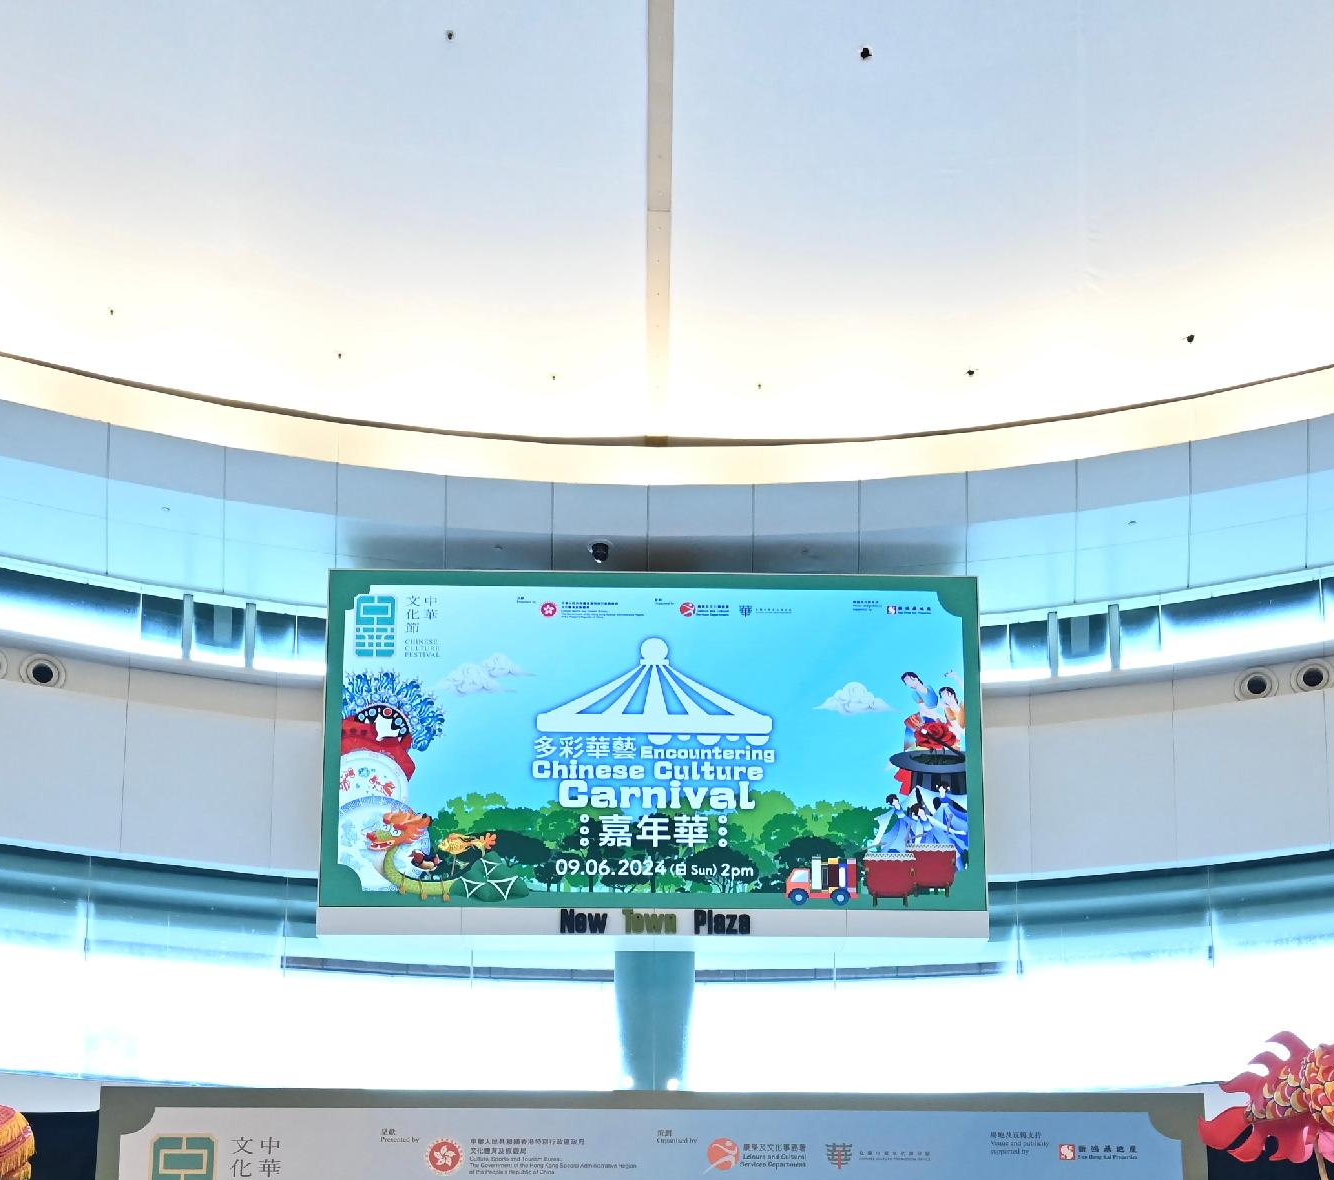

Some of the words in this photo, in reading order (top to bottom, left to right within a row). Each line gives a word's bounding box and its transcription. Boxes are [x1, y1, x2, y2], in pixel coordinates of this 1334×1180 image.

[534, 736, 637, 760] 多彩華藝
[640, 746, 775, 764] Encountering
[532, 760, 645, 780] Chinese
[654, 761, 764, 781] Culture
[559, 779, 756, 810] Carnival
[598, 814, 709, 848] 嘉年華
[555, 859, 667, 877] 09.06.2024
[721, 863, 755, 879] 2pm
[559, 908, 608, 934] New
[622, 908, 678, 934] Town
[693, 909, 751, 935] Plaza
[411, 1136, 420, 1144] by
[259, 1137, 282, 1178] 中華
